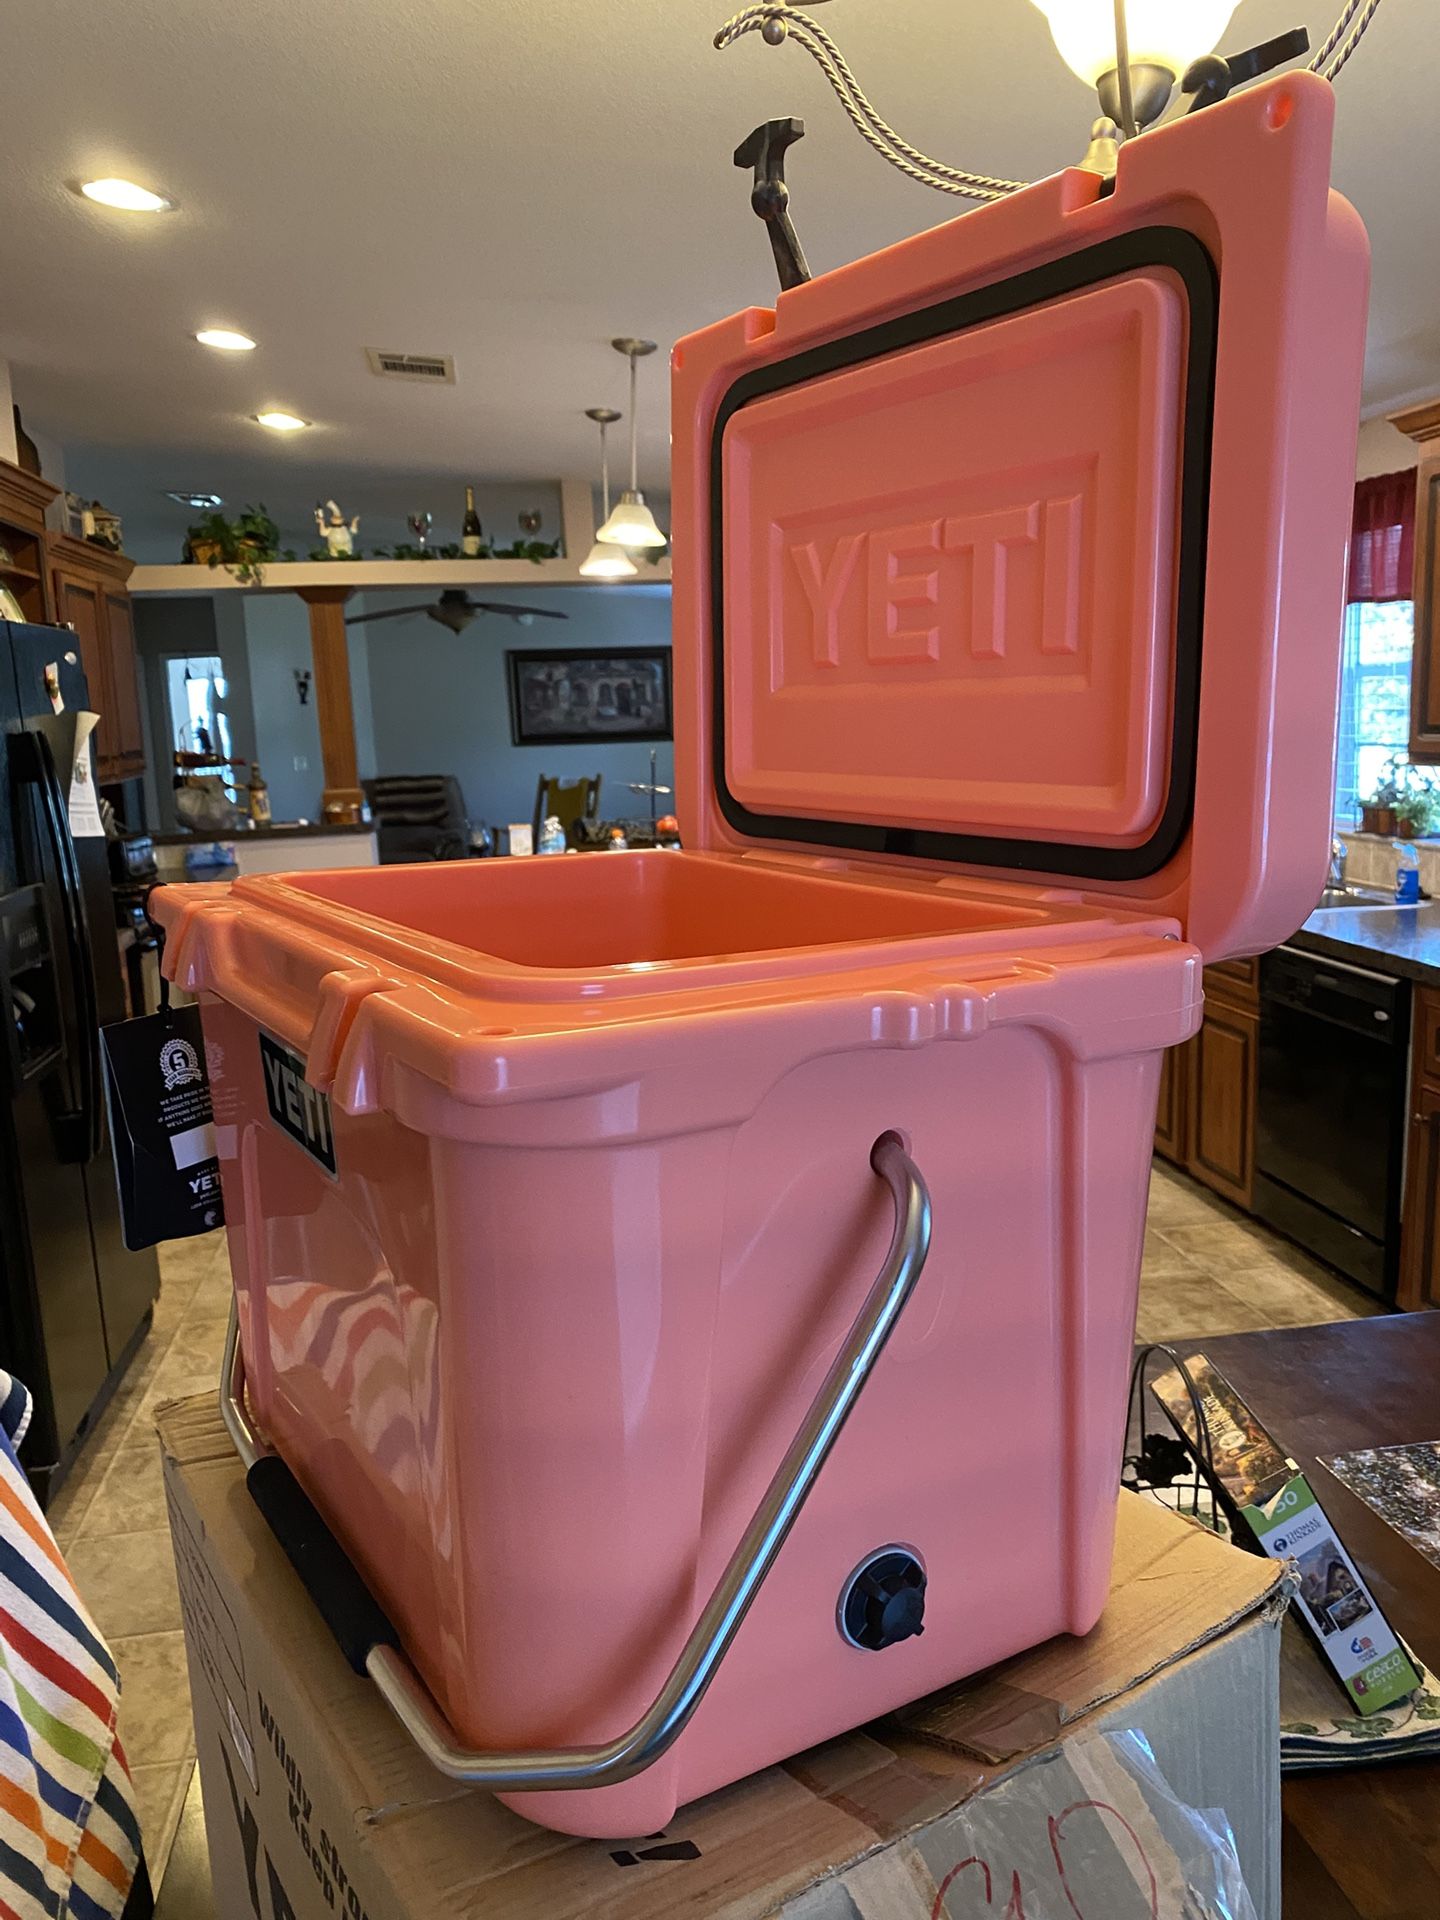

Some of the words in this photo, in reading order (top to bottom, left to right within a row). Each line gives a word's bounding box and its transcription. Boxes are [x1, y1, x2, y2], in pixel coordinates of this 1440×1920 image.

[791, 493, 1083, 668] YETI
[173, 1052, 186, 1070] 5
[263, 1050, 328, 1154] YETI
[189, 1172, 221, 1193] YET
[257, 1689, 313, 1824] Wildly
[320, 1828, 370, 1920] stro
[288, 1786, 335, 1911] Keep
